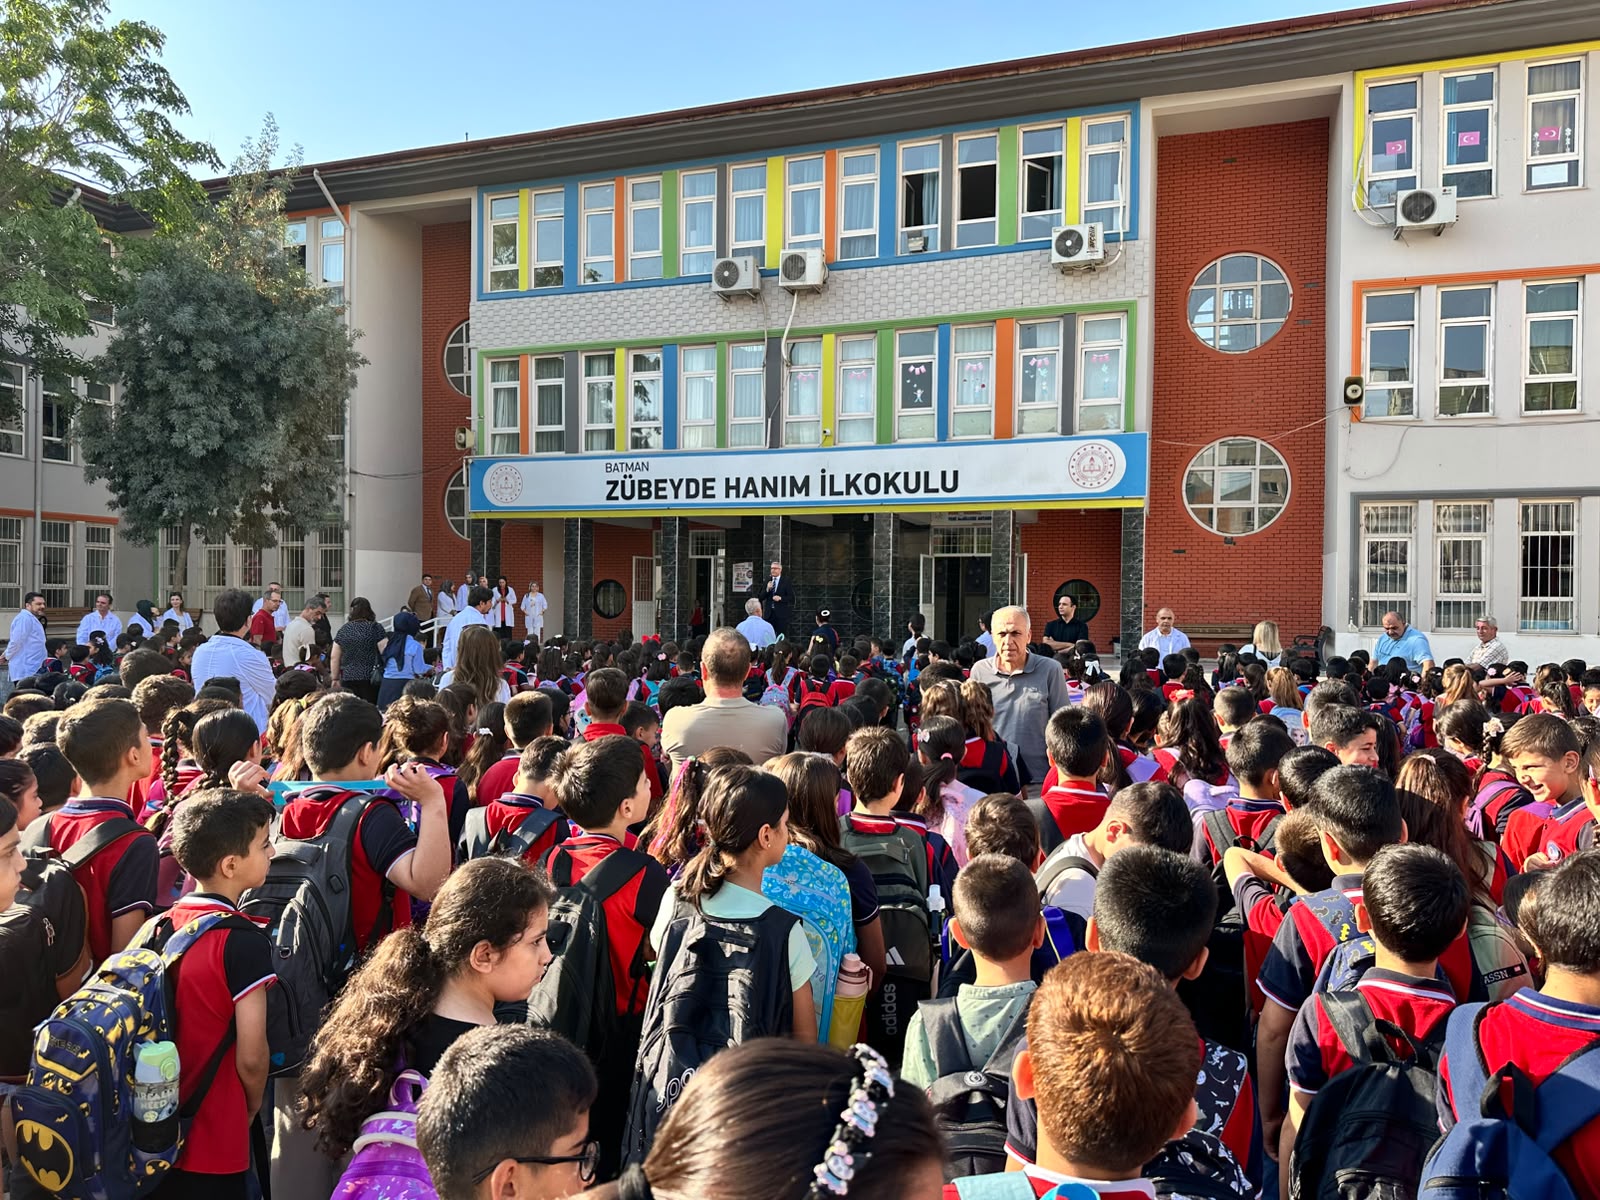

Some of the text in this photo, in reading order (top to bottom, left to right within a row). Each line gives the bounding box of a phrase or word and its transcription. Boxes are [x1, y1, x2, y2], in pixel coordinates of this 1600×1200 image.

[605, 461, 650, 473] BATMAN
[605, 468, 959, 501] ZÜBEYDE HANIM İLKOKULU
[882, 983, 897, 1036] adidas
